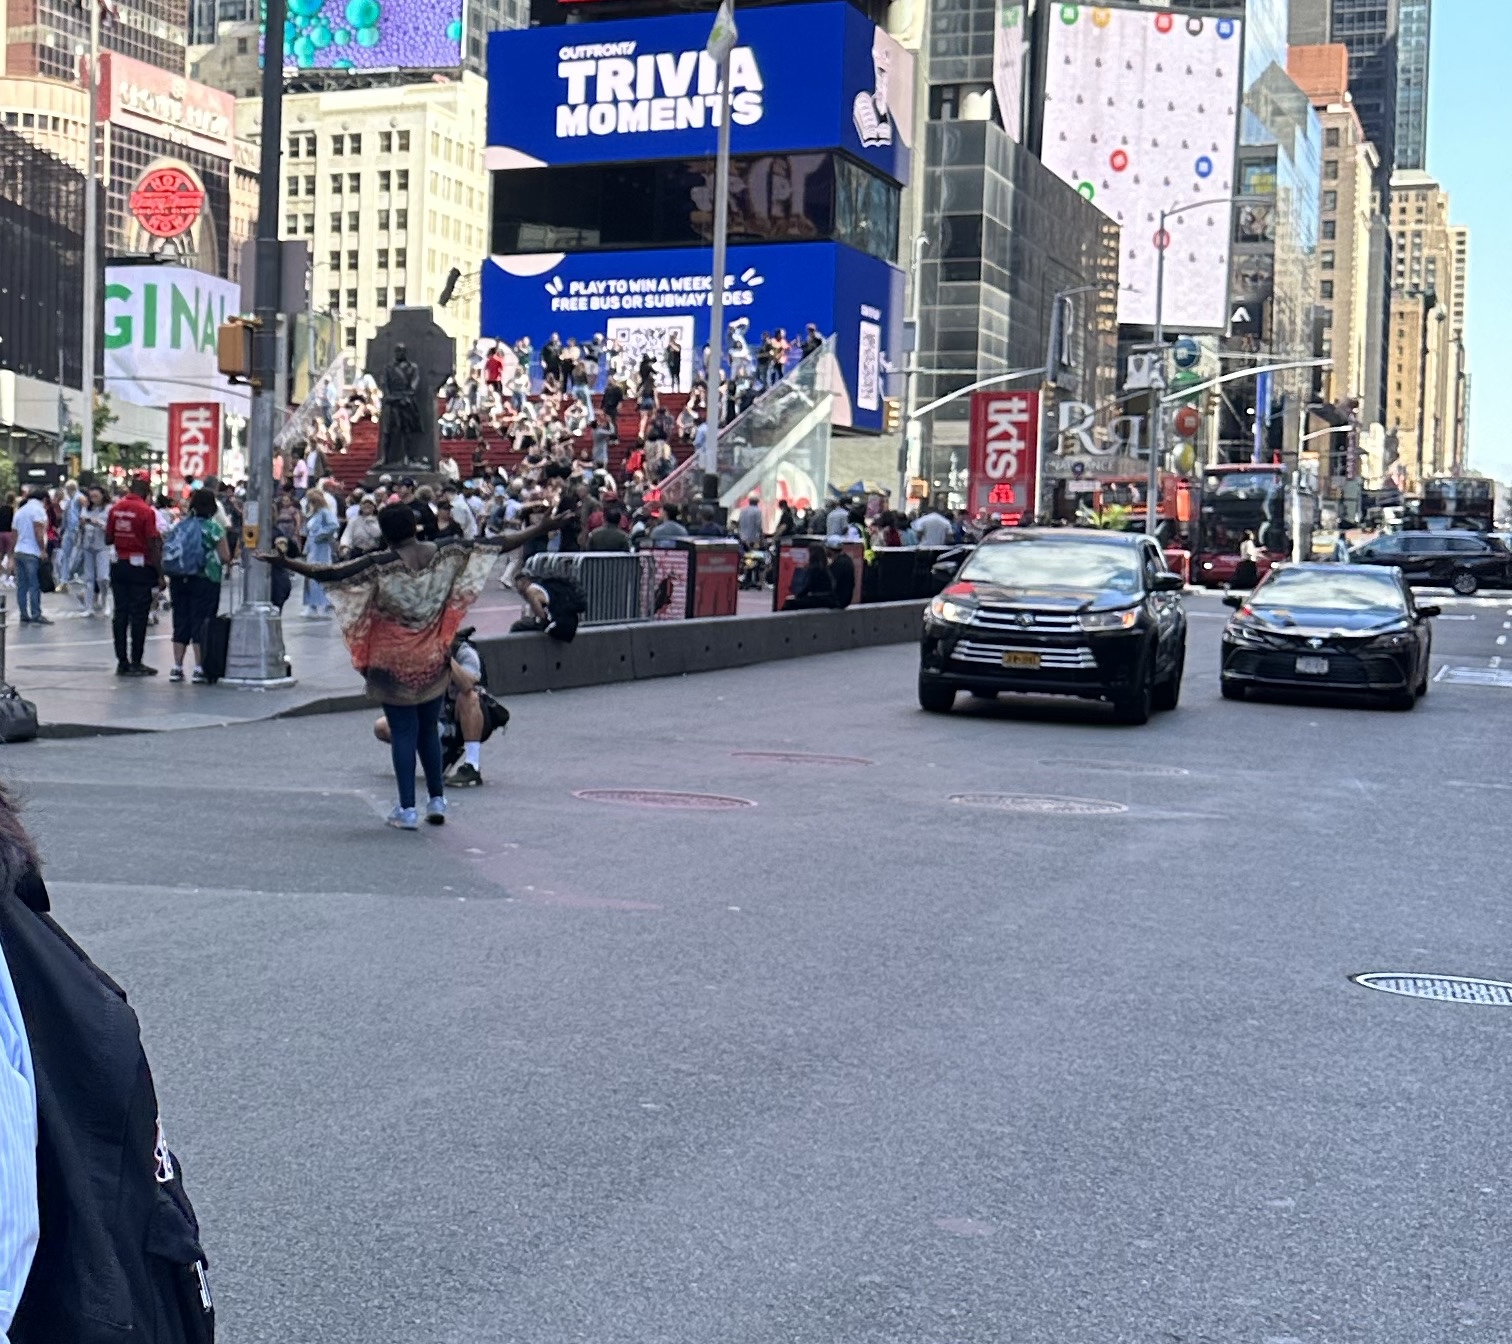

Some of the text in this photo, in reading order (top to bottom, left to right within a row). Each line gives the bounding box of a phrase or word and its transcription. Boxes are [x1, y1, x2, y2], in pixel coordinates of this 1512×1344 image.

[557, 46, 764, 106] TRIVIA
[556, 91, 764, 138] MOMENTS
[551, 296, 589, 312] FREE
[589, 294, 621, 311] BUS
[624, 293, 645, 309] OR
[644, 291, 707, 309] SUBWAY
[569, 279, 607, 296] PLAY
[607, 278, 629, 295] TO
[628, 277, 657, 294] WIN
[657, 276, 672, 293] A
[672, 275, 713, 292] WEEK
[180, 407, 213, 477] tkts
[985, 397, 1030, 479] tkts
